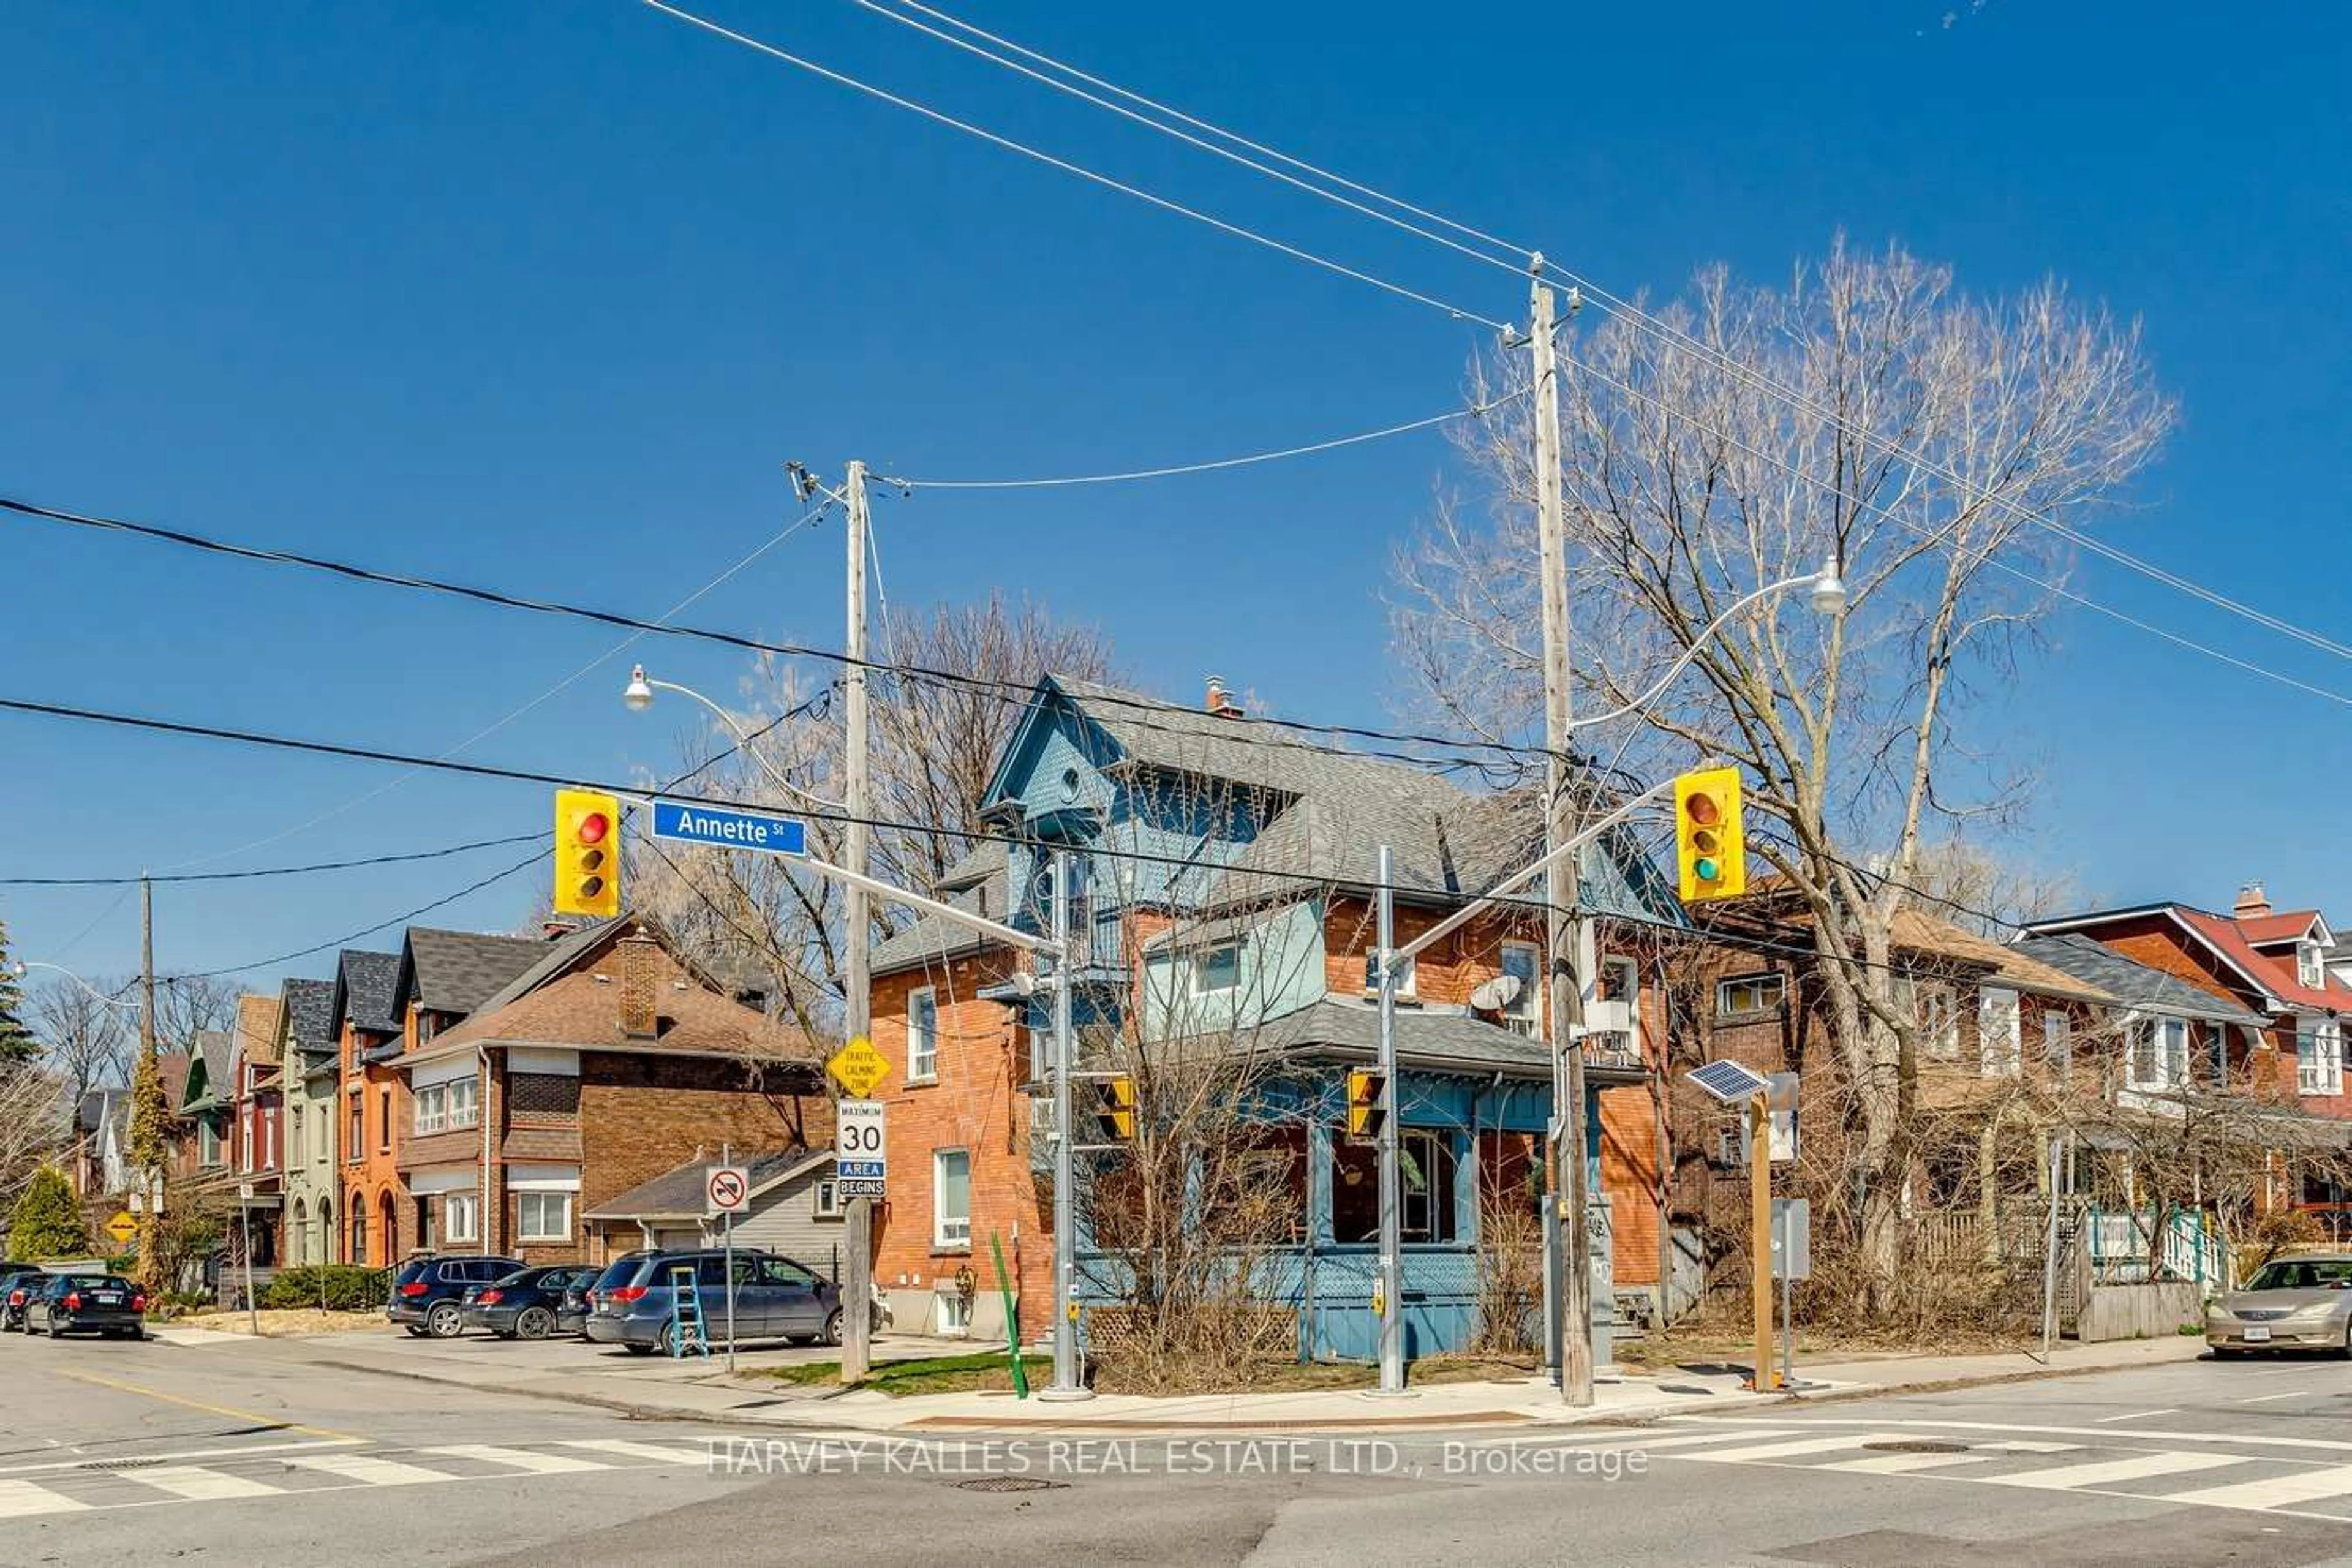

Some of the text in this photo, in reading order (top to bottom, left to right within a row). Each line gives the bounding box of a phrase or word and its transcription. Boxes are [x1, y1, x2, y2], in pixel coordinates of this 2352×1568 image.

[677, 810, 784, 843] Annette St
[846, 1051, 876, 1061] TRAFFIC
[845, 1065, 876, 1076] CALMING
[851, 1078, 869, 1089] ZONE
[842, 1107, 881, 1116] MAXIMUM
[843, 1125, 881, 1151] 30
[845, 1163, 880, 1175] AREA
[841, 1181, 884, 1193] BEGINS
